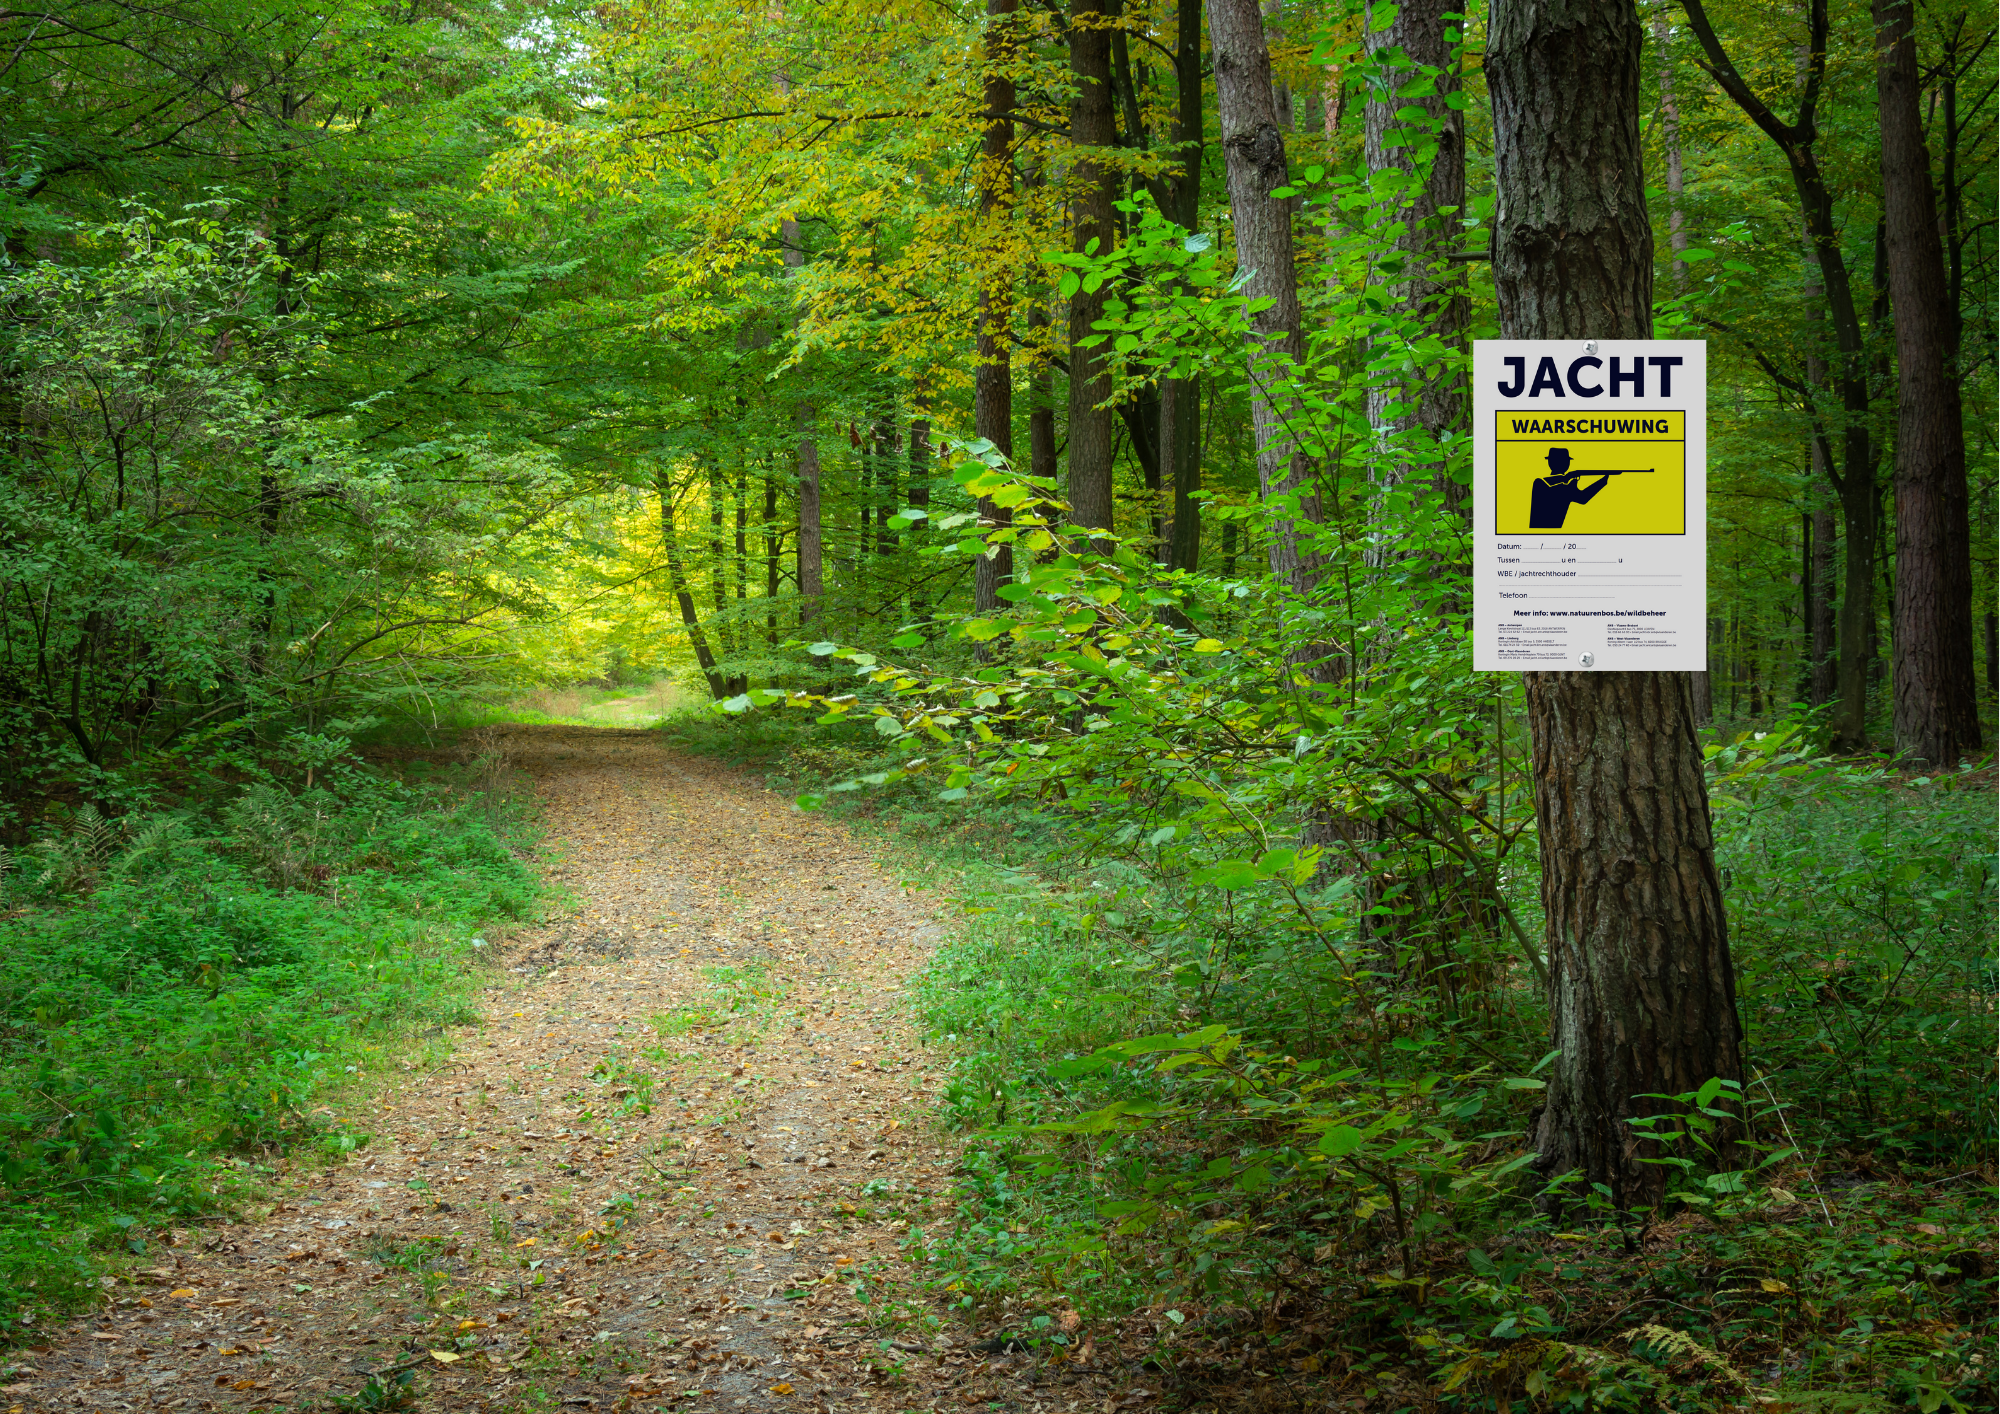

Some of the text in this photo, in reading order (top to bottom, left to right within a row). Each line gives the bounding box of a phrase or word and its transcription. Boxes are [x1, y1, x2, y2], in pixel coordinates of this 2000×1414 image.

[1497, 356, 1683, 398] JACHT
[1512, 419, 1669, 434] WAARSCHUWING
[1518, 570, 1576, 578] jachtrechthouder
[1514, 609, 1666, 617] Meer info: www.natuurenbos.be/wildbeheer
